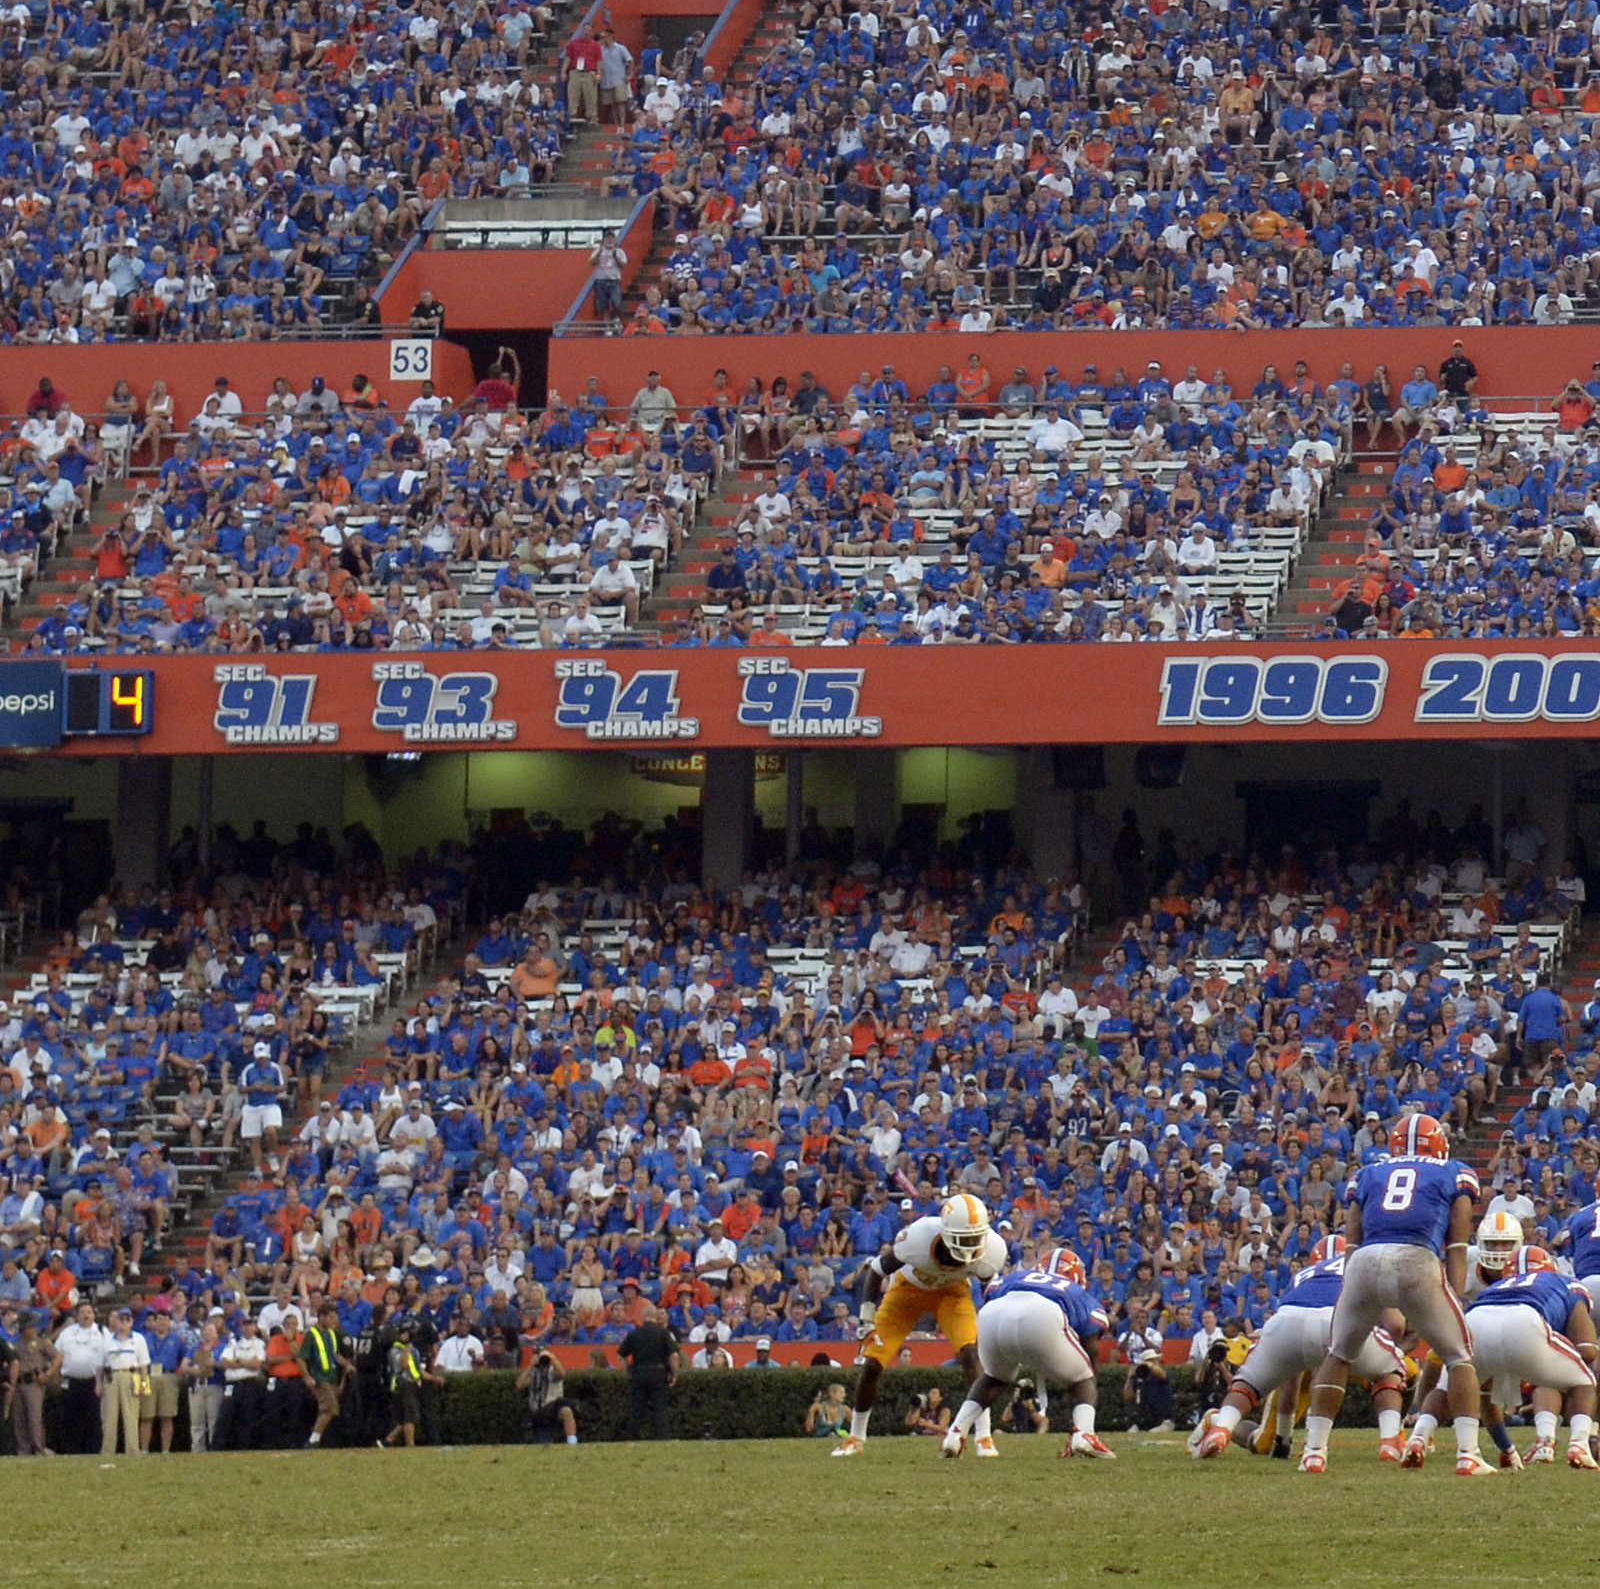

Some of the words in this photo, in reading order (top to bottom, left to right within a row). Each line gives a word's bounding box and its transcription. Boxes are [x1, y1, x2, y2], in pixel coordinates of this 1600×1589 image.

[392, 345, 429, 374] 53
[214, 663, 266, 682] SEC
[373, 661, 423, 680] SEC
[555, 659, 606, 679] SEC
[738, 656, 790, 676] SEC
[111, 675, 143, 725] 4
[373, 670, 498, 731] 93
[555, 668, 681, 729] 94
[738, 666, 865, 727] 95
[1158, 654, 1389, 726] 1996
[214, 673, 315, 732] 91
[226, 722, 338, 744] CHAMPS
[403, 720, 517, 742] CHAMPS
[587, 717, 699, 740] CHAMPS
[768, 715, 882, 738] CHAMPS
[1067, 1116, 1088, 1138] 97
[1382, 1168, 1416, 1211] 8
